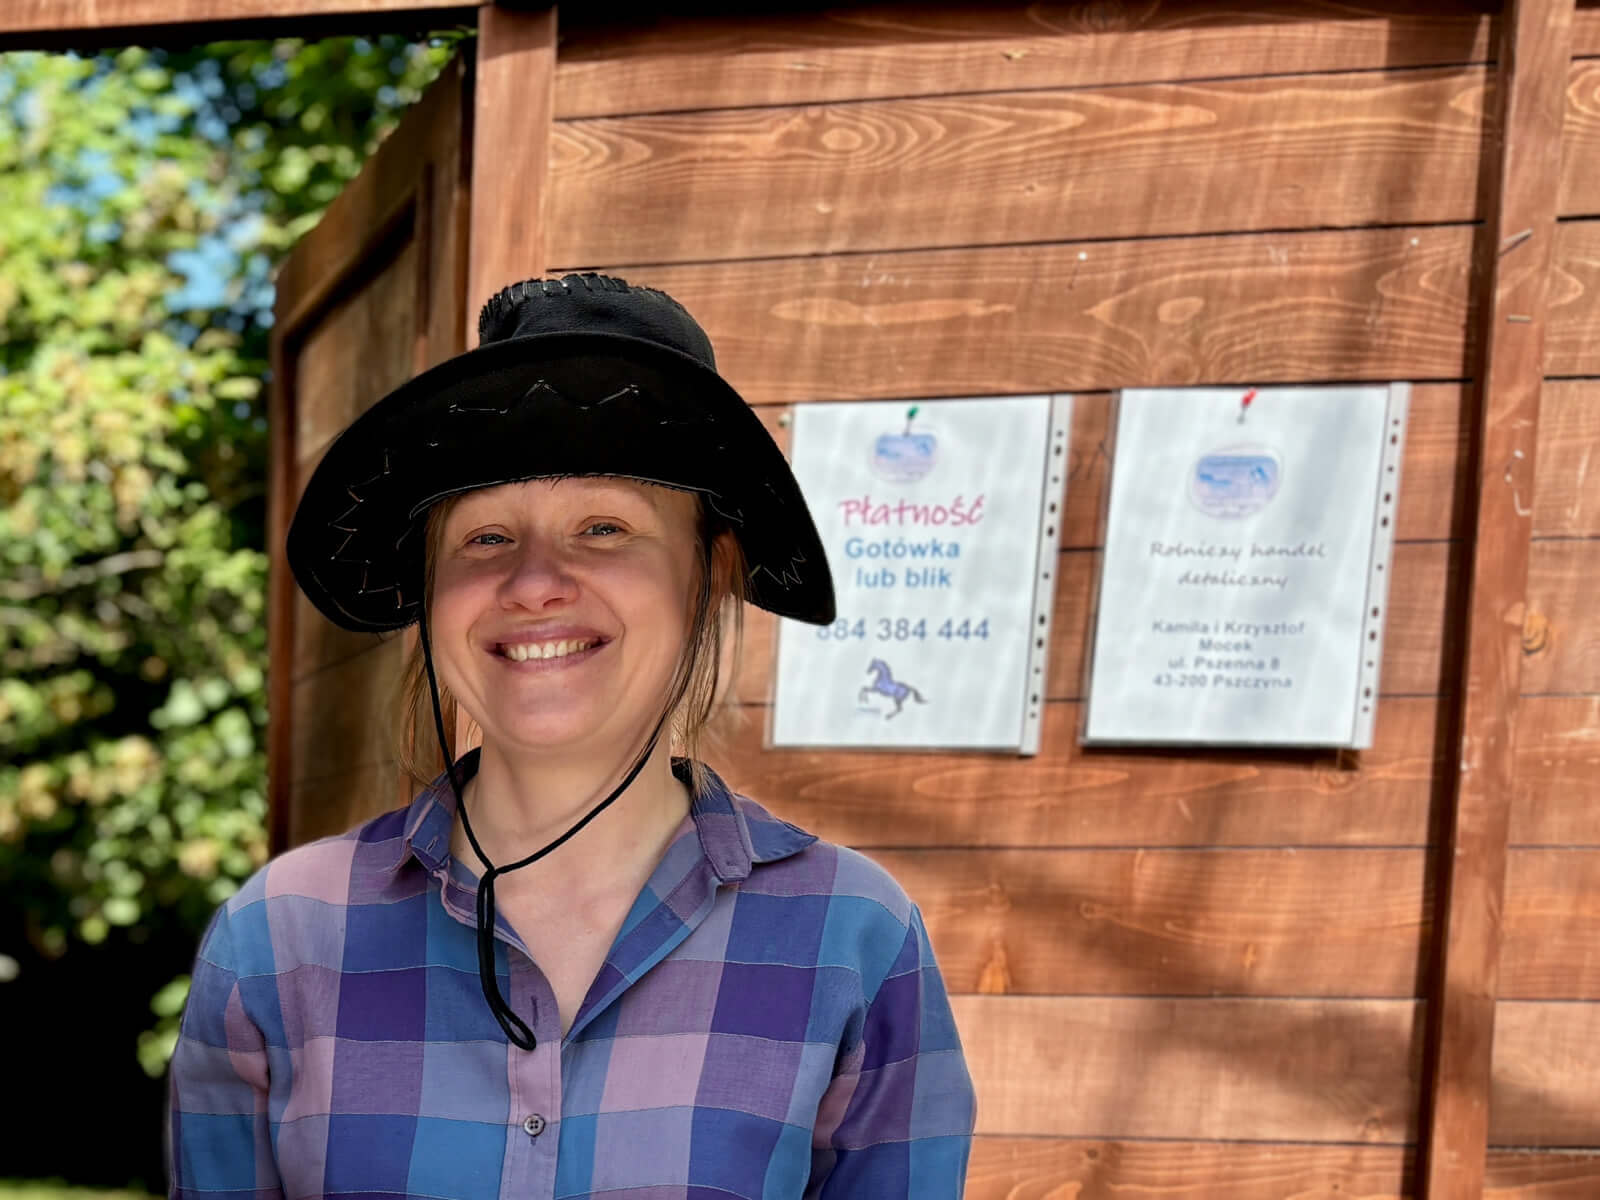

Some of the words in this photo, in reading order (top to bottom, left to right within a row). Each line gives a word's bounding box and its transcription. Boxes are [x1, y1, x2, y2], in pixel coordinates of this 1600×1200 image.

[838, 494, 985, 527] Płatność
[845, 536, 961, 559] Gotówka
[856, 567, 896, 588] lub
[905, 567, 952, 588] blik
[876, 618, 928, 641] 384
[937, 618, 990, 641] 444
